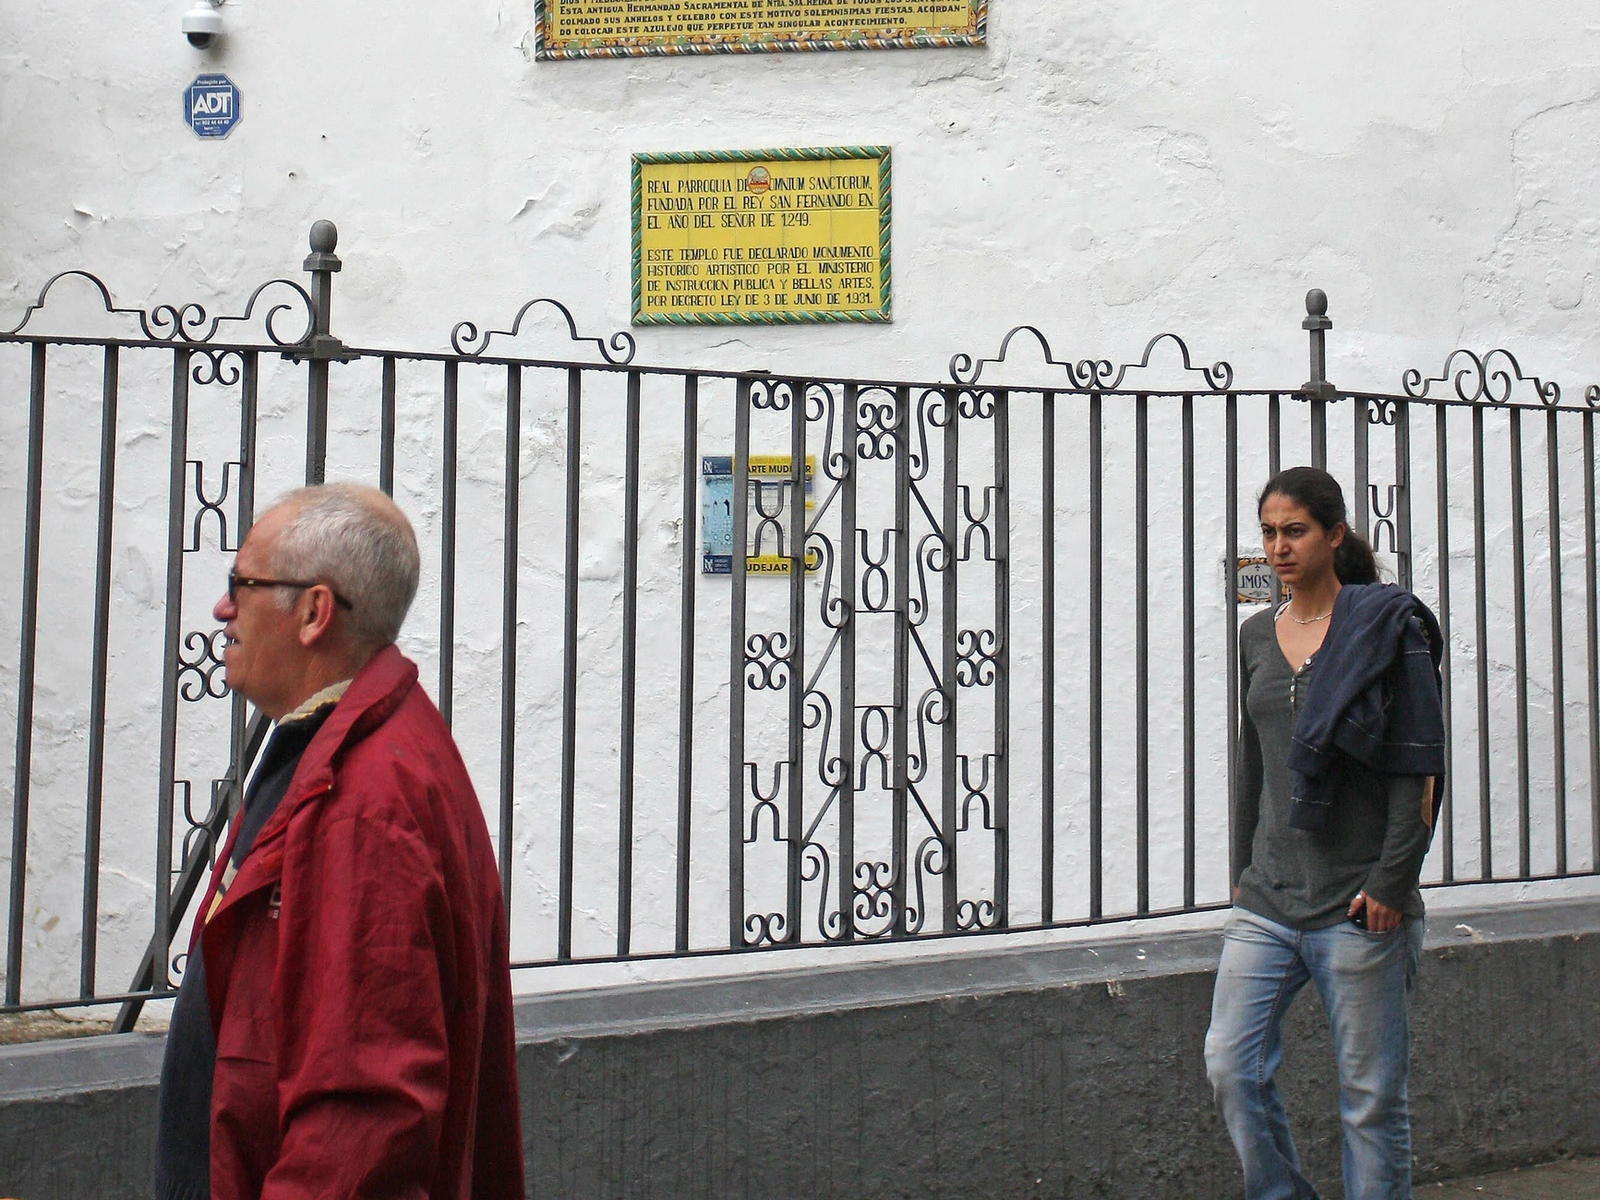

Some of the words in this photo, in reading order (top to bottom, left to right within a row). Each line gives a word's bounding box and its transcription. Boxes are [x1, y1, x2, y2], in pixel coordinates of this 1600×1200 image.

[587, 6, 624, 14] ANTIGUA
[624, 15, 663, 23] ANHELOS
[740, 11, 764, 19] ESTE
[767, 10, 801, 18] MOTIVO
[804, 8, 871, 17] SOLEMNISIMAS
[560, 28, 571, 36] DO
[575, 27, 613, 35] COLOCAR
[616, 26, 639, 34] ESTE
[643, 24, 683, 32] AZULEJO
[687, 23, 704, 31] QUE
[707, 22, 754, 30] PERPETUE
[758, 21, 774, 29] TAN
[778, 20, 821, 28] SINGULAR
[194, 92, 231, 114] ADT
[647, 180, 672, 193] REAL
[678, 179, 732, 193] PARROQUIA
[737, 179, 750, 192] DE
[769, 177, 805, 191] OMNIUM
[647, 198, 694, 211] FUNDADA
[699, 197, 719, 210] POR
[724, 196, 737, 209] EL
[743, 196, 764, 209] REY
[770, 195, 791, 209] SAN
[797, 194, 853, 208] FERNANDO
[858, 193, 873, 207] EN
[647, 216, 661, 229] EL
[668, 214, 689, 229] AÑO
[694, 214, 715, 228] DEL
[721, 213, 755, 228] SEÑOR
[761, 213, 775, 227] DE
[647, 249, 674, 261] ESTE
[679, 248, 718, 260] TEMPLO
[723, 248, 743, 260] FUE
[749, 247, 809, 260] DECLARADO
[813, 246, 874, 258] MONUMENTO
[647, 264, 699, 276] HISTORICO
[706, 264, 760, 275] ARTISTICO
[768, 263, 790, 274] POR
[797, 263, 811, 274] EL
[819, 262, 874, 273] MINISTERIO
[647, 280, 661, 291] DE
[666, 280, 729, 291] INSTRUCCION
[733, 279, 775, 290] PUBLICA
[780, 279, 787, 289] Y
[793, 278, 832, 289] BELLAS
[647, 295, 667, 306] POR
[672, 295, 716, 306] DECRETO
[721, 295, 741, 306] LEY
[745, 294, 759, 305] DE
[763, 294, 770, 305] 3
[775, 294, 788, 305] DE
[794, 293, 822, 305] JUNIO
[827, 293, 840, 304] DE
[746, 563, 788, 572] UDEJAR
